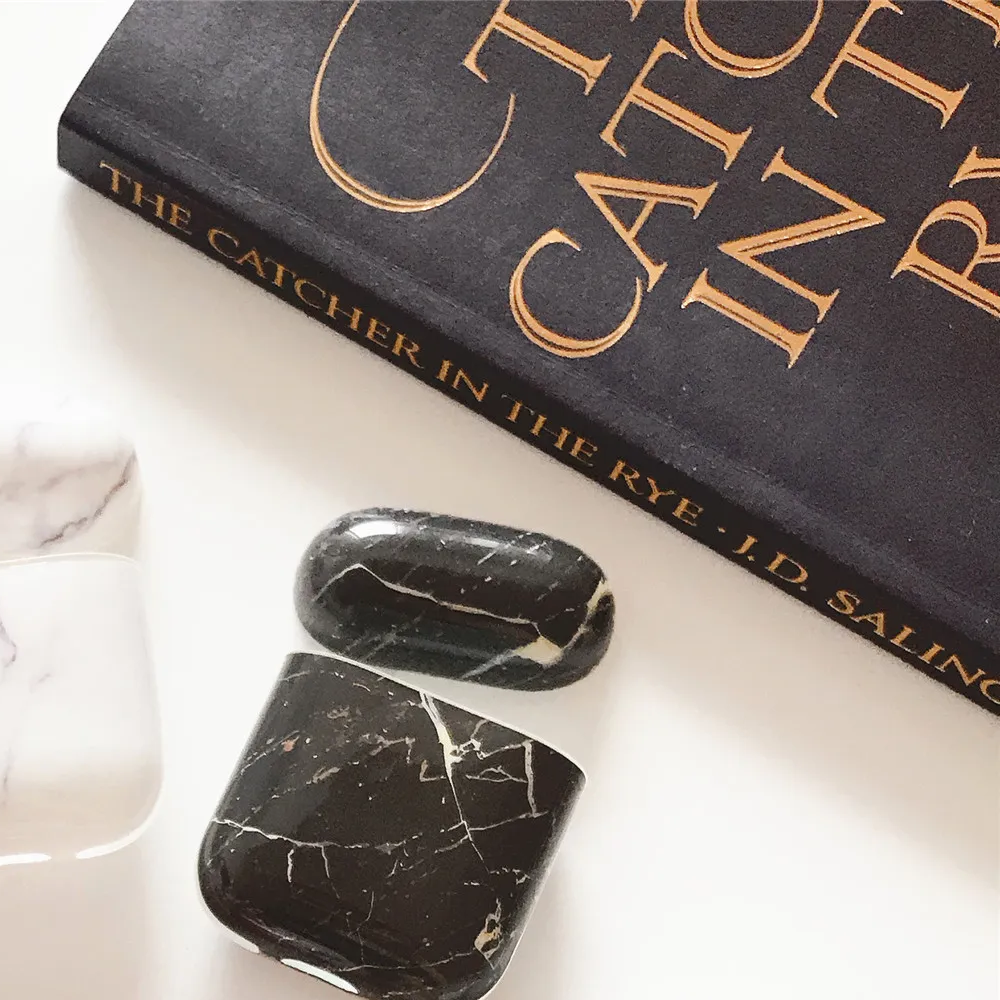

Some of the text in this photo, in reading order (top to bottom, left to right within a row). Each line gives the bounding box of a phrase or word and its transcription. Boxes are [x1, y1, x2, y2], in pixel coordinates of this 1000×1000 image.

[99, 160, 193, 236] THE
[207, 226, 425, 370] CATCHER
[436, 359, 490, 403] IN
[500, 393, 599, 468] THE
[608, 459, 704, 527] RYE
[681, 0, 1000, 369] IN T
